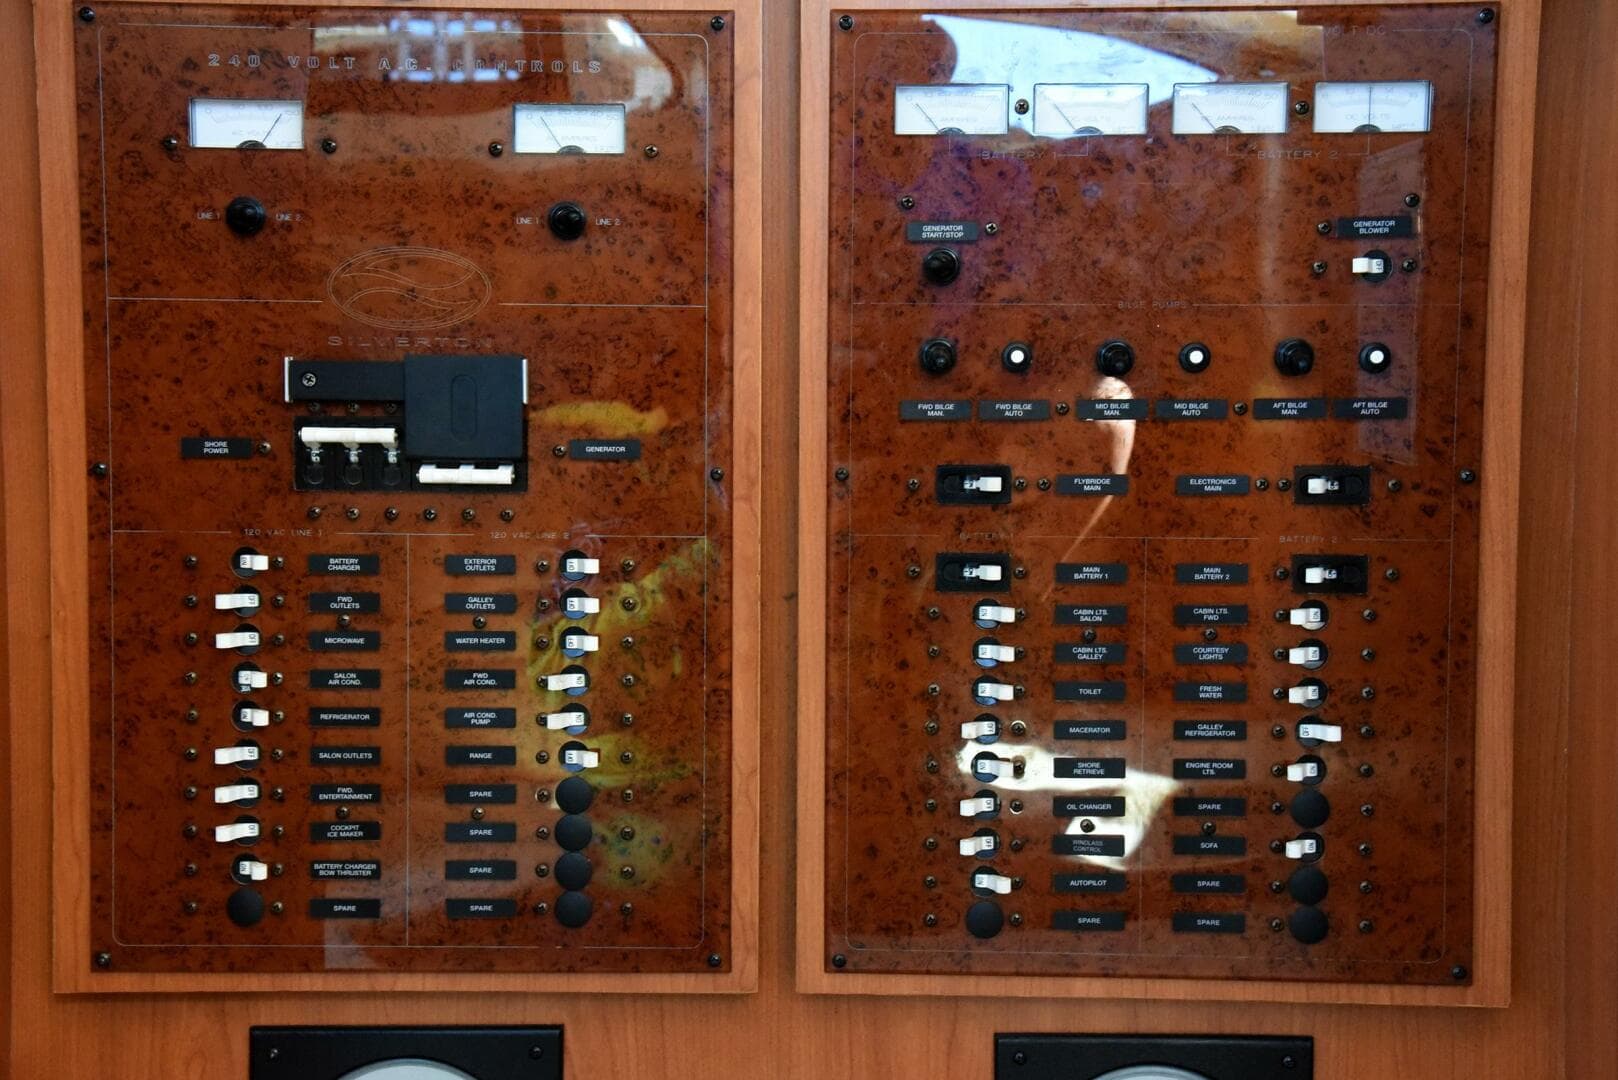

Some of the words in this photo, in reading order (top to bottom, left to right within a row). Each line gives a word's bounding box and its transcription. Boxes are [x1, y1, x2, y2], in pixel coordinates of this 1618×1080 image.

[1366, 26, 1386, 36] DC
[207, 54, 261, 68] 240
[287, 56, 355, 70] VOLT
[378, 57, 432, 71] A.C.
[451, 58, 601, 73] CONTROLS
[981, 151, 1045, 160] BATTERY
[1257, 150, 1321, 160] BATTERY
[1328, 150, 1339, 160] 2
[196, 212, 212, 220] LINE
[276, 213, 292, 221] LINE
[516, 217, 532, 225] LINE
[596, 218, 612, 226] LINE
[614, 218, 622, 226] 2
[1353, 220, 1396, 228] GENERATOR
[1118, 300, 1147, 309] BILGE
[1152, 300, 1187, 309] PUMPS
[327, 335, 493, 348] SILVERTON
[1012, 403, 1032, 411] BILGE
[1174, 402, 1188, 410] MID
[1188, 402, 1209, 410] BILGE
[1004, 409, 1024, 417] AUTO
[244, 528, 261, 537] 120
[267, 528, 286, 537] VAC
[290, 528, 312, 537] LINE
[490, 531, 507, 540] 120
[512, 531, 531, 540] VAC
[563, 531, 570, 540] 2
[1279, 535, 1324, 544] BATTERY
[1072, 845, 1102, 853] CONTROL
